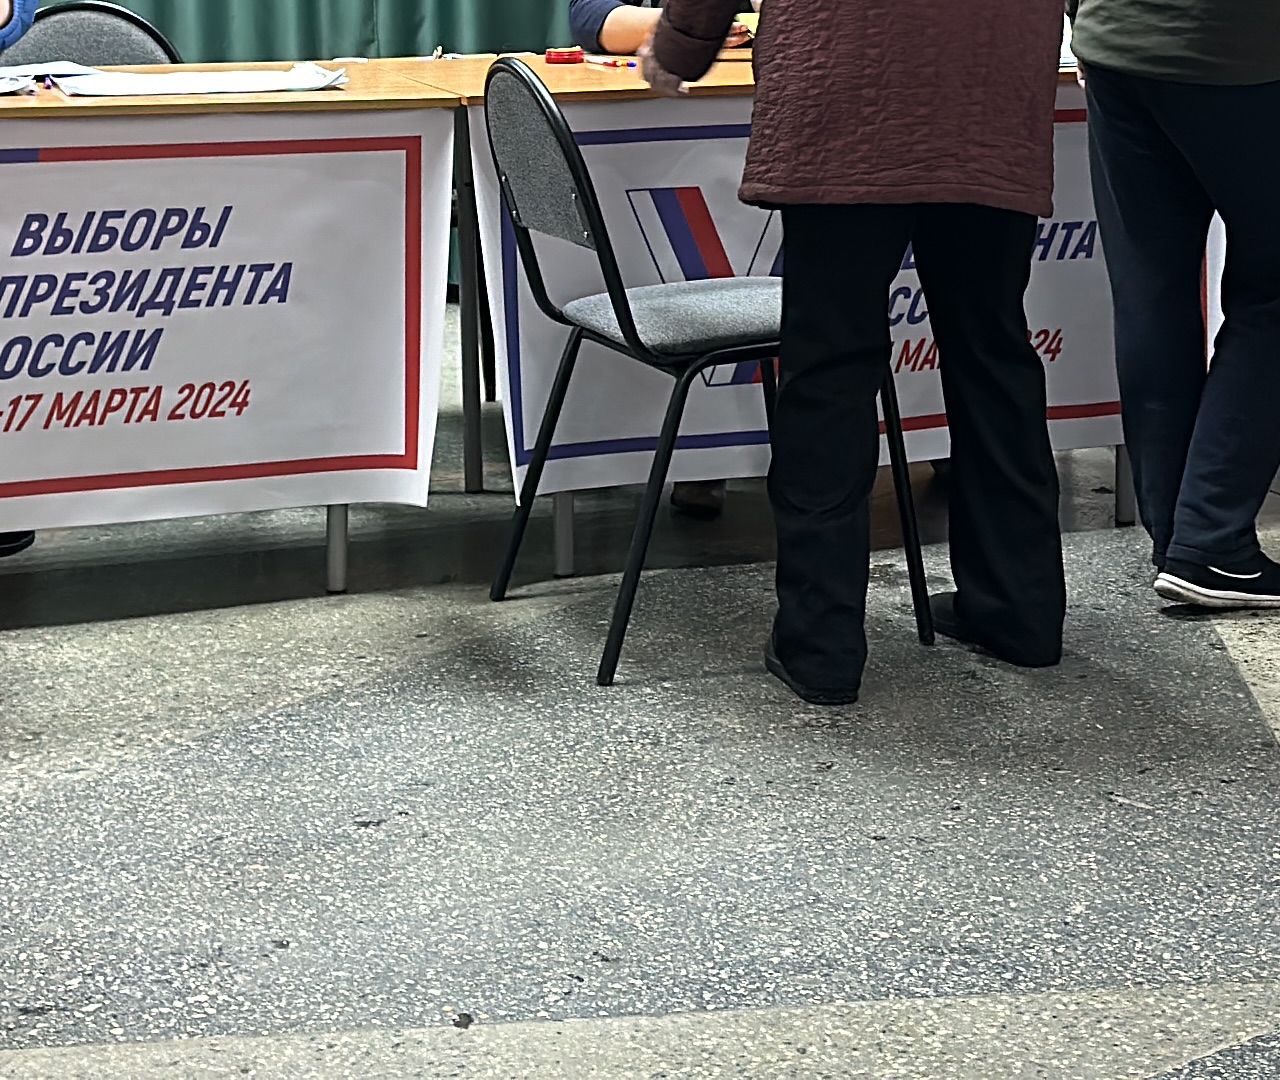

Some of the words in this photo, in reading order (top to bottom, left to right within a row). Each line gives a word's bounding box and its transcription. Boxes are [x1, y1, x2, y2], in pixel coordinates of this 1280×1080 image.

[11, 205, 233, 257] ВЫБОРЫ
[43, 384, 163, 430] МАРТА
[167, 379, 251, 421] 2024
